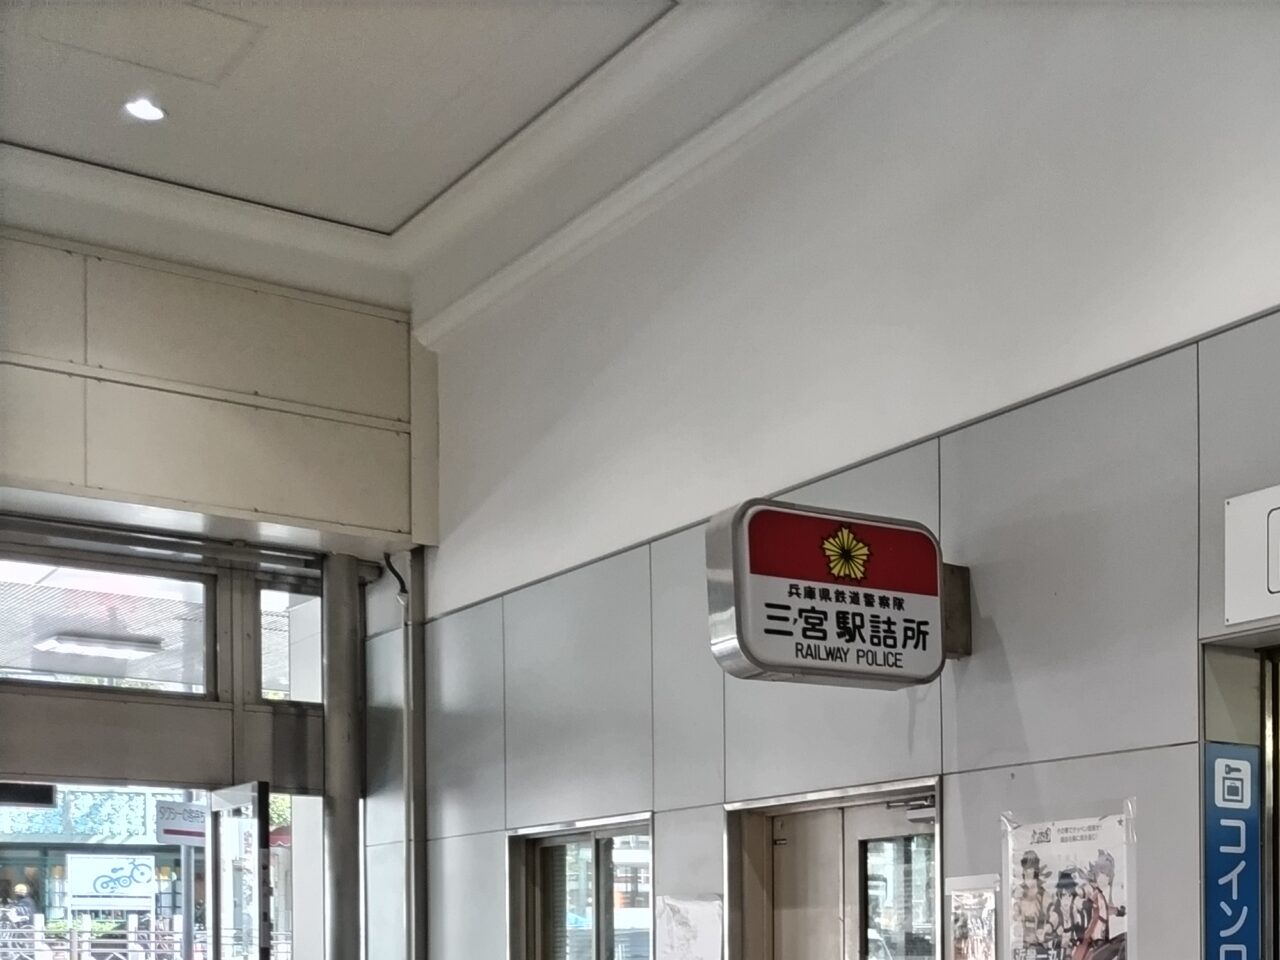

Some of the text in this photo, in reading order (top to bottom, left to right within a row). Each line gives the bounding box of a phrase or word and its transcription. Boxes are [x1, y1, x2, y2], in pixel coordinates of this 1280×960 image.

[787, 583, 905, 612] 兵庫県鉄道警察隊
[795, 642, 904, 669] RAILWAY POLICE
